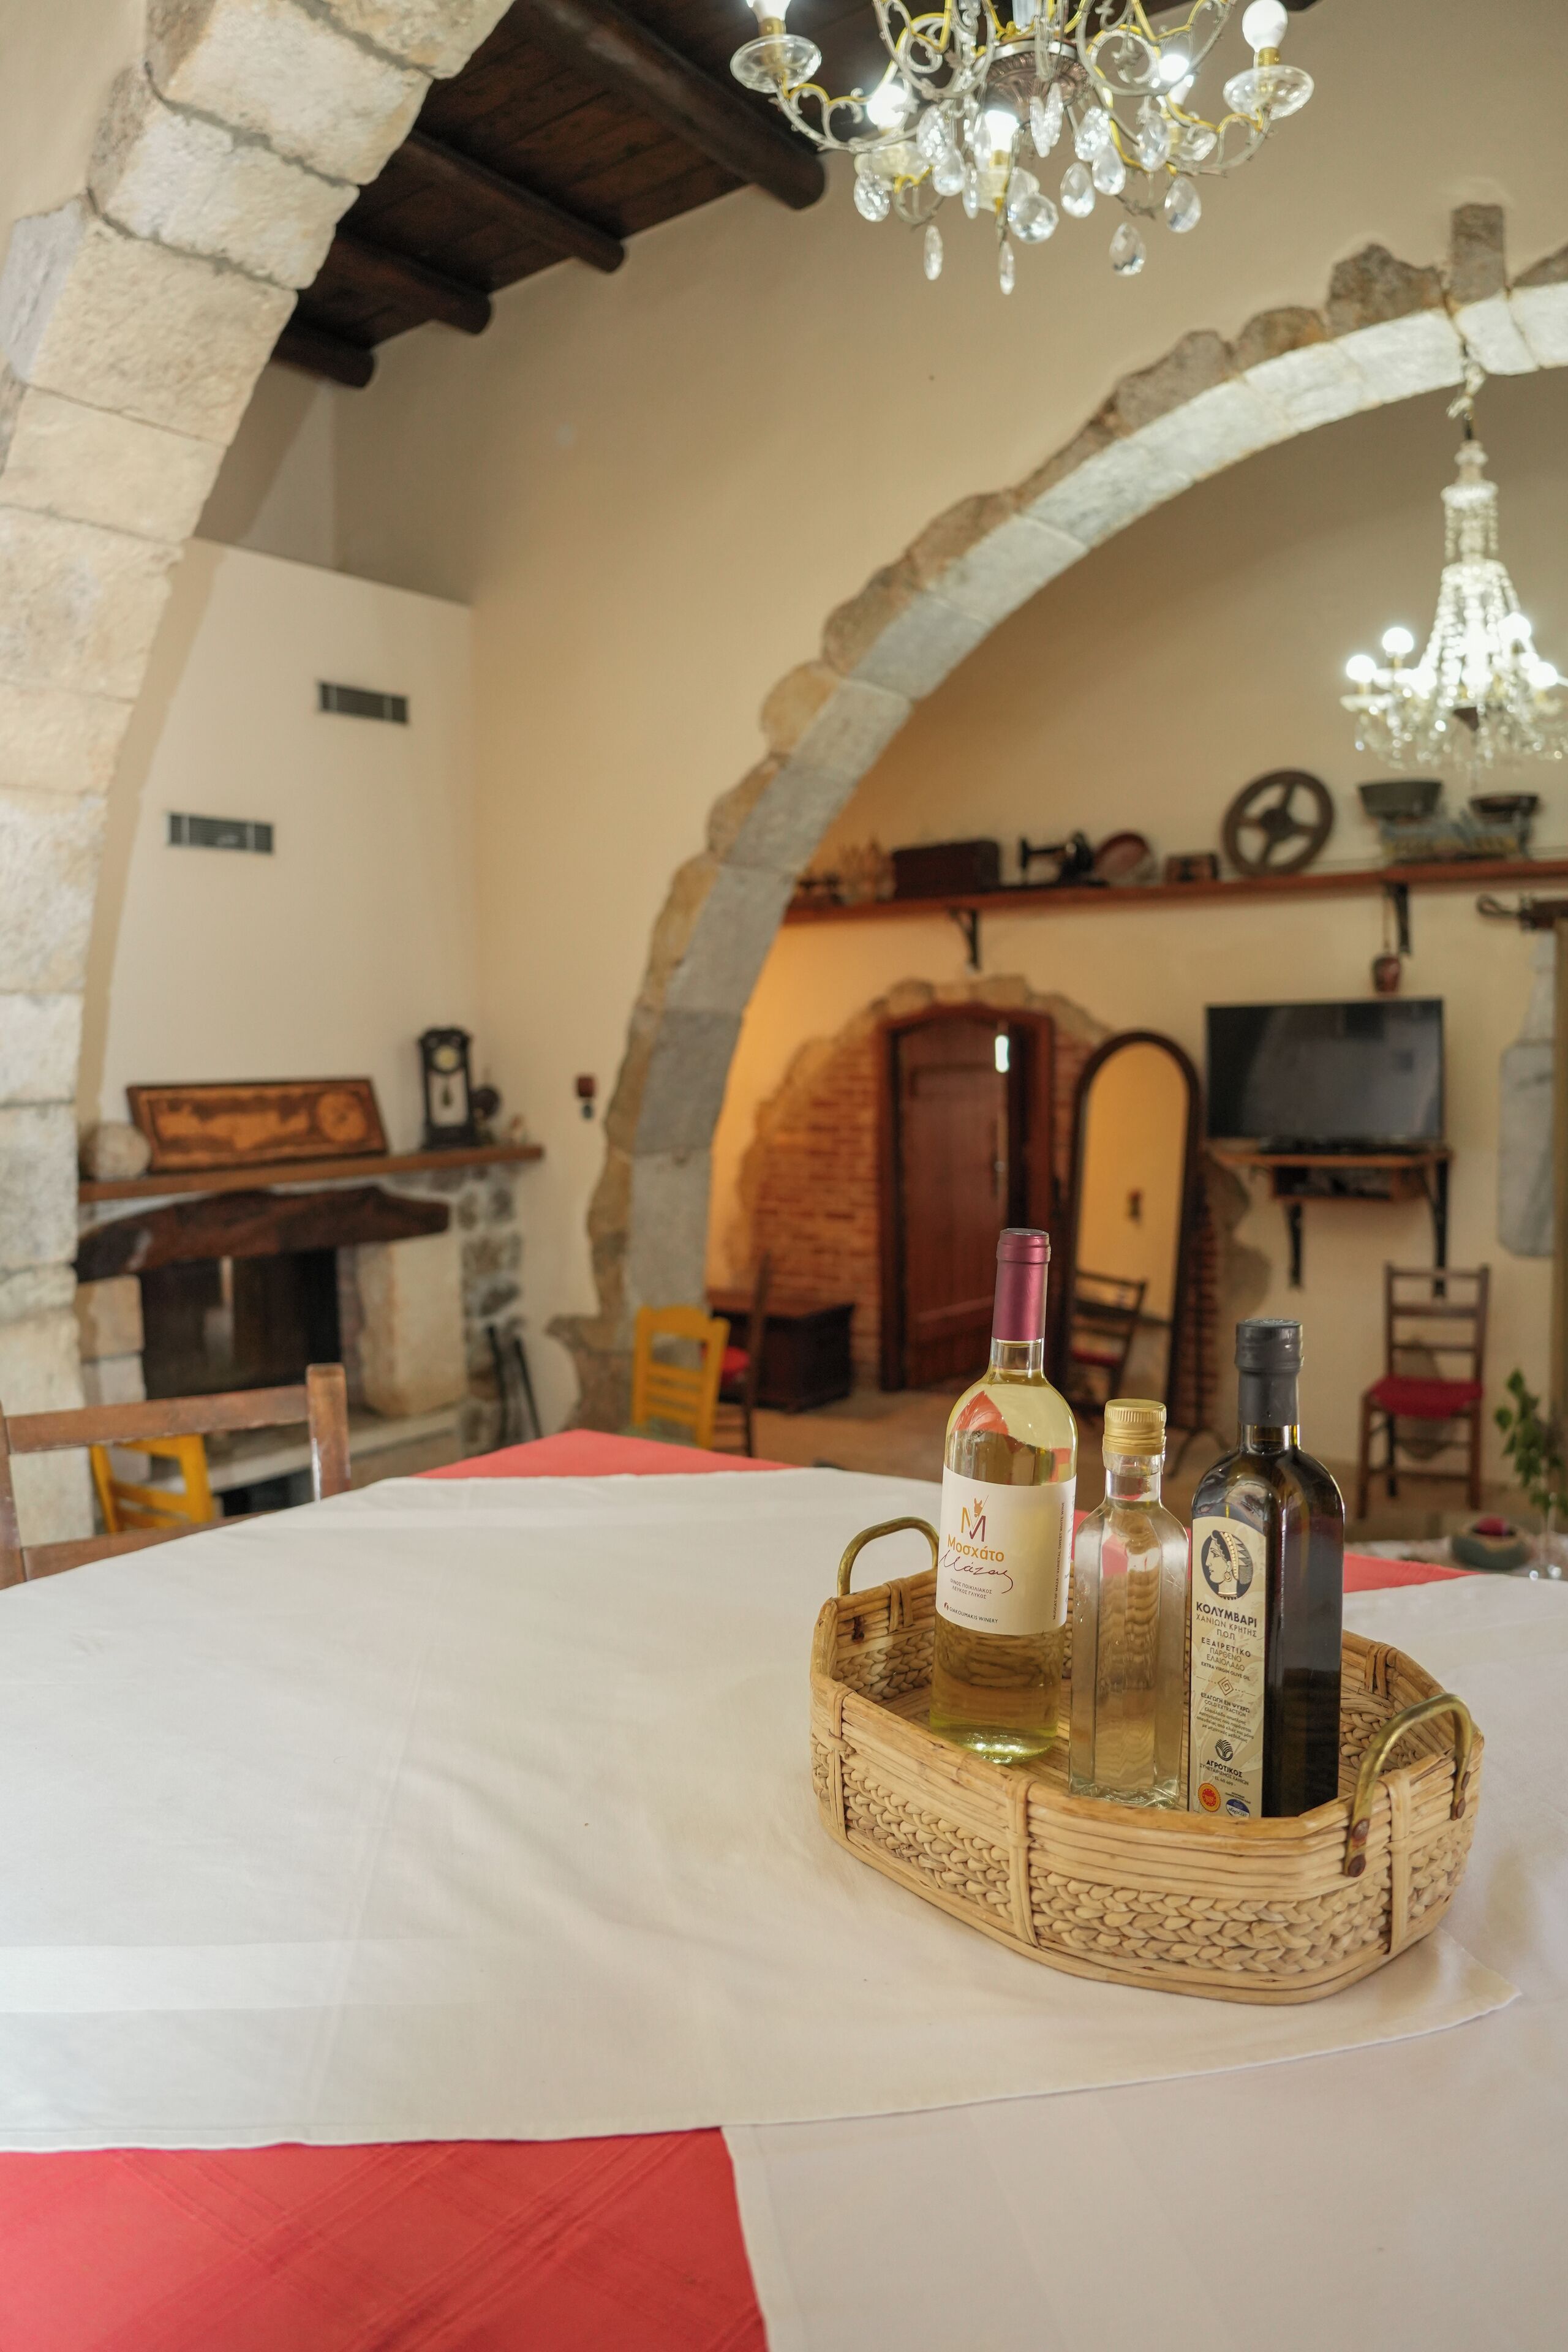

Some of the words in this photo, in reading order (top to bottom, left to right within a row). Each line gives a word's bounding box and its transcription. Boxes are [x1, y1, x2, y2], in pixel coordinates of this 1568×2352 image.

[948, 1533, 1005, 1562] Μοσχάτο
[950, 1578, 962, 1587] ΟΙΝΟΣ
[962, 1583, 992, 1594] ΠΟΙΚΙΛΙΑΚΟΣ
[952, 1585, 968, 1595] ΛΕΥΚΟΣ
[968, 1591, 987, 1599] ΓΛΥΚΟΣ
[949, 1607, 978, 1620] GIAKOUMAKIS
[1196, 1601, 1257, 1628] ΚΟΛΥΜΒΑΡΙ
[1196, 1613, 1226, 1628] ΧΑΝΙΩΝ
[1229, 1623, 1257, 1637] ΚΡΗΤΗΣ
[1201, 1637, 1251, 1657] ΕΞΑΙΡΕΤΙΚΟ
[1210, 1647, 1242, 1662] ΠΑΡΘΕΝΟ
[1207, 1654, 1245, 1672] ΕΛΑΙΟΛΑΔΟ
[1215, 1665, 1230, 1674] VIRGIN
[1200, 1692, 1223, 1703] ΕΞΑΓΩΓΗ
[1232, 1703, 1250, 1713] ΨΥΧΡΩ
[1218, 1704, 1246, 1717] EXTRACTION
[1206, 1759, 1243, 1778] ΑΓΡΟΤΙΚΟΣ
